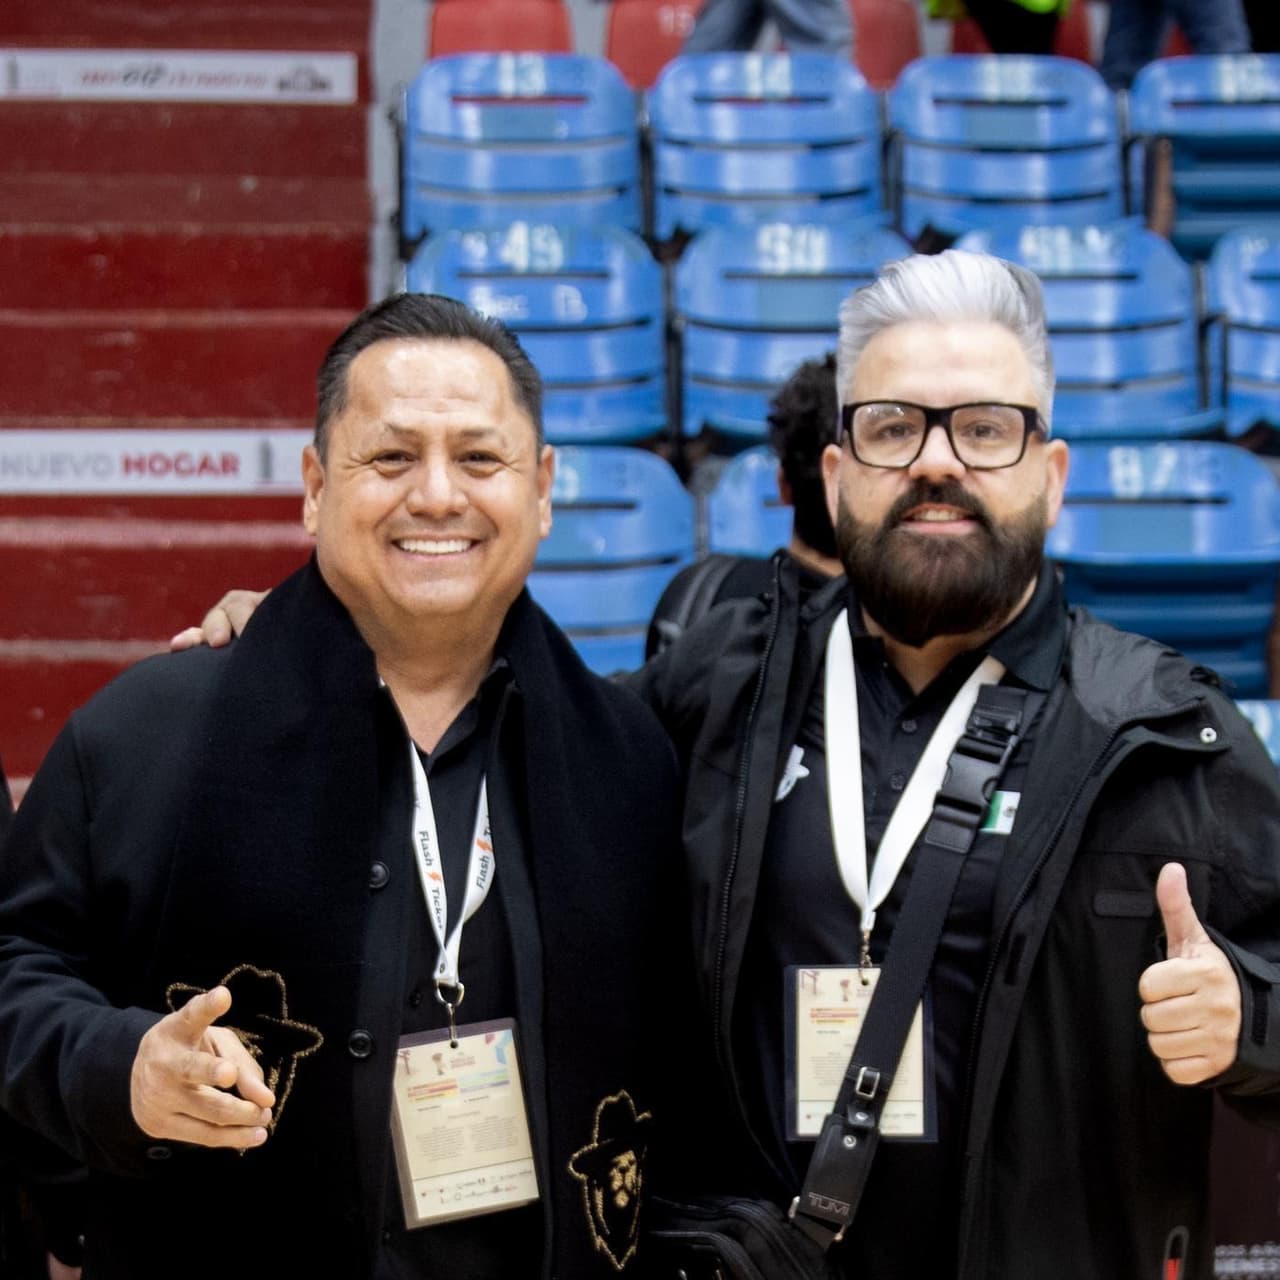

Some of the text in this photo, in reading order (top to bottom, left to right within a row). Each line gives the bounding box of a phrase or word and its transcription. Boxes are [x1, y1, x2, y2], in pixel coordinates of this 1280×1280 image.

[123, 451, 240, 477] HOGAR
[418, 829, 434, 867] Flash
[476, 854, 491, 890] Flash
